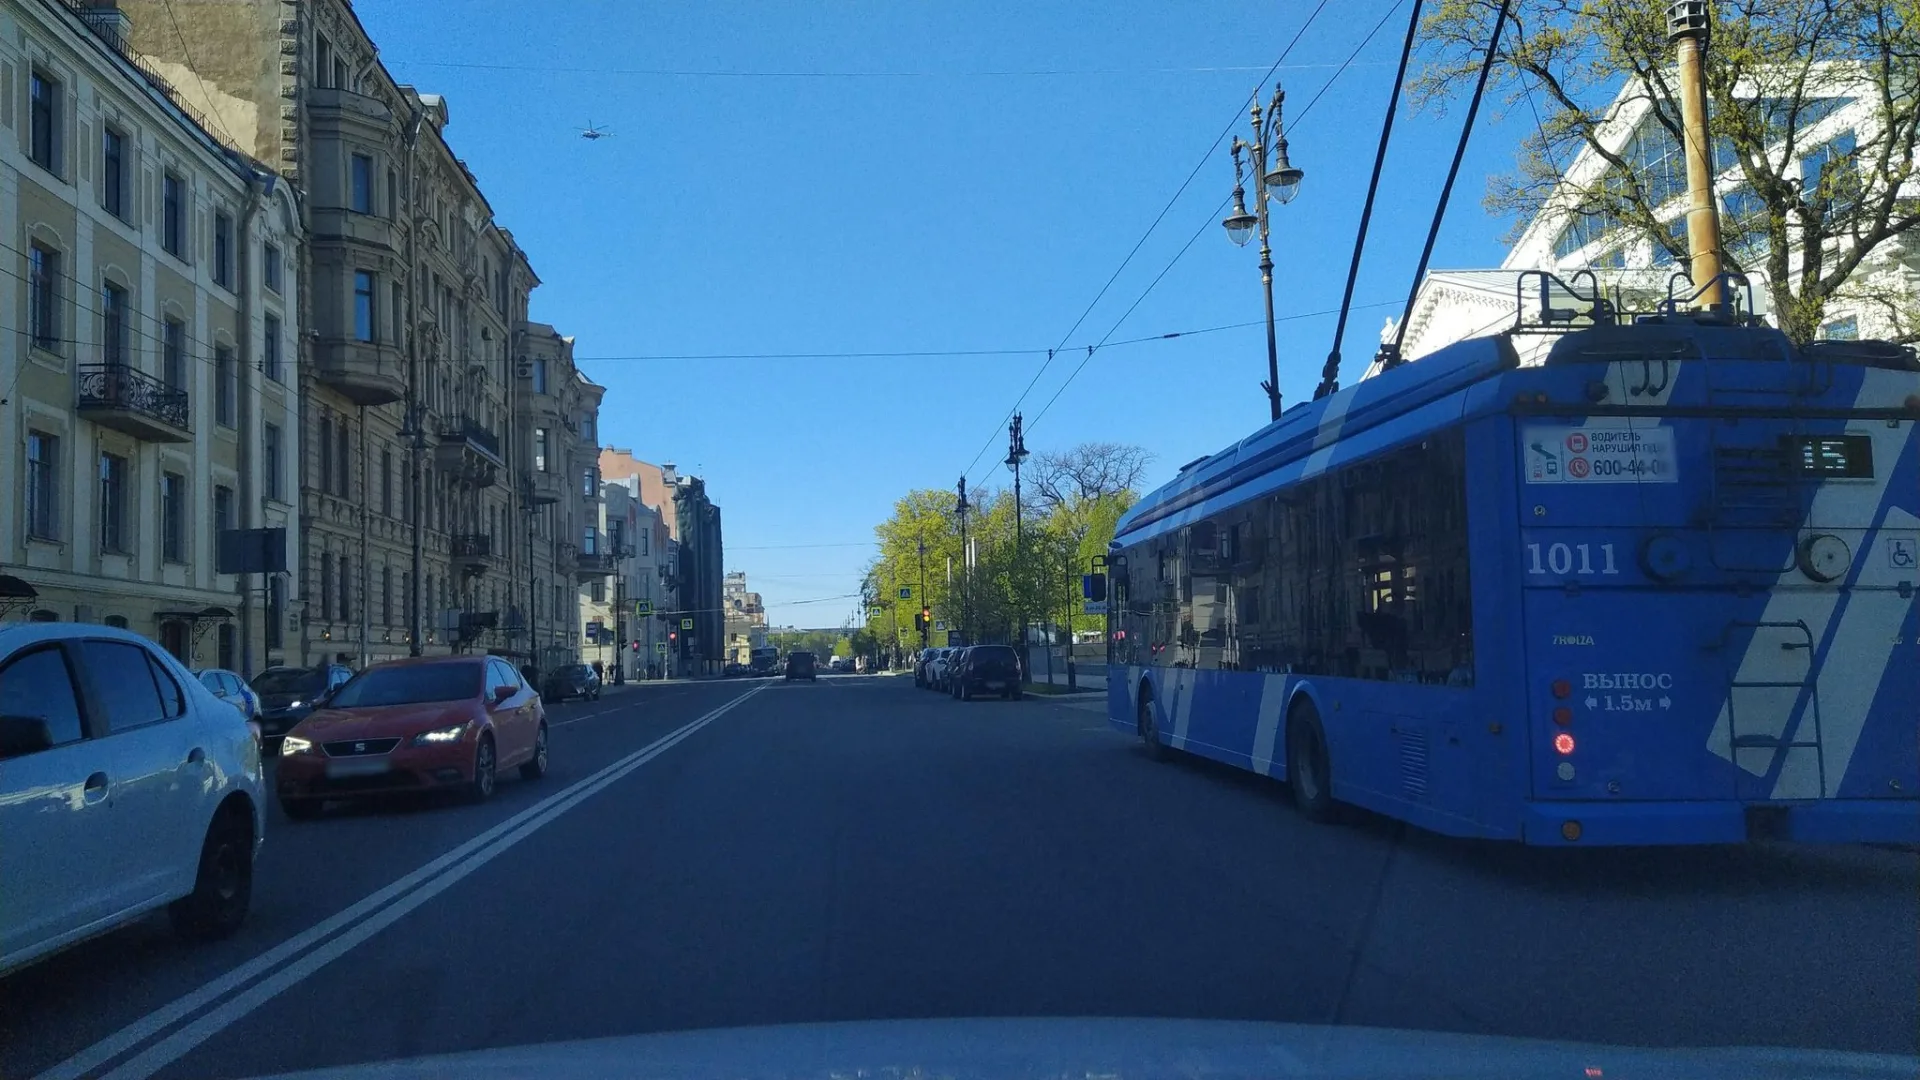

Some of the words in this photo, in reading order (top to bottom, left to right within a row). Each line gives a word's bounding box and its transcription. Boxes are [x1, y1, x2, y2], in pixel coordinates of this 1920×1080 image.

[1591, 432, 1641, 442] ВОДИТЕЛЬ
[1592, 444, 1641, 453] НАРУШИЛ
[1803, 441, 1846, 469] 15
[1594, 459, 1669, 475] 600-44-0
[1527, 542, 1619, 574] 1011
[1582, 673, 1673, 689] ВЫНОС
